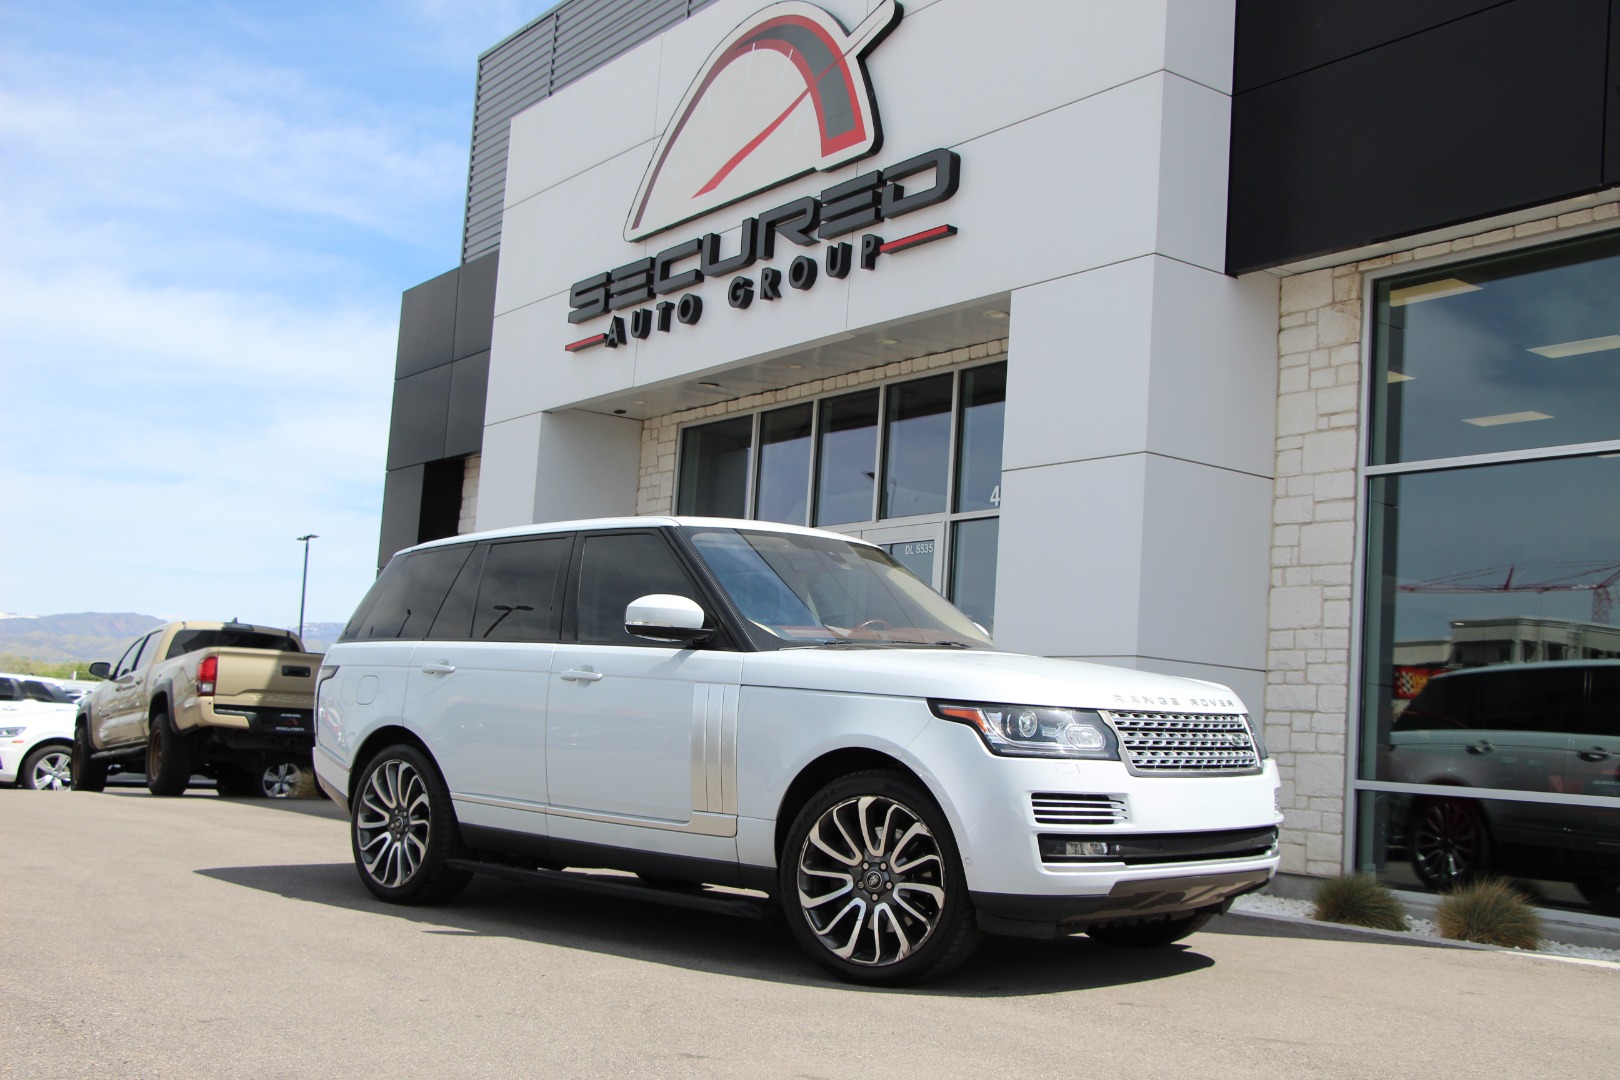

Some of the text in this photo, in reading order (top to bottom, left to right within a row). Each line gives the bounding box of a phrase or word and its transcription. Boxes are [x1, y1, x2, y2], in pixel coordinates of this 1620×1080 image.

[568, 148, 961, 324] SECURED
[604, 234, 883, 348] AUTO GROUP
[905, 543, 934, 555] DL 5535
[1113, 694, 1235, 708] RANGE ROVER
